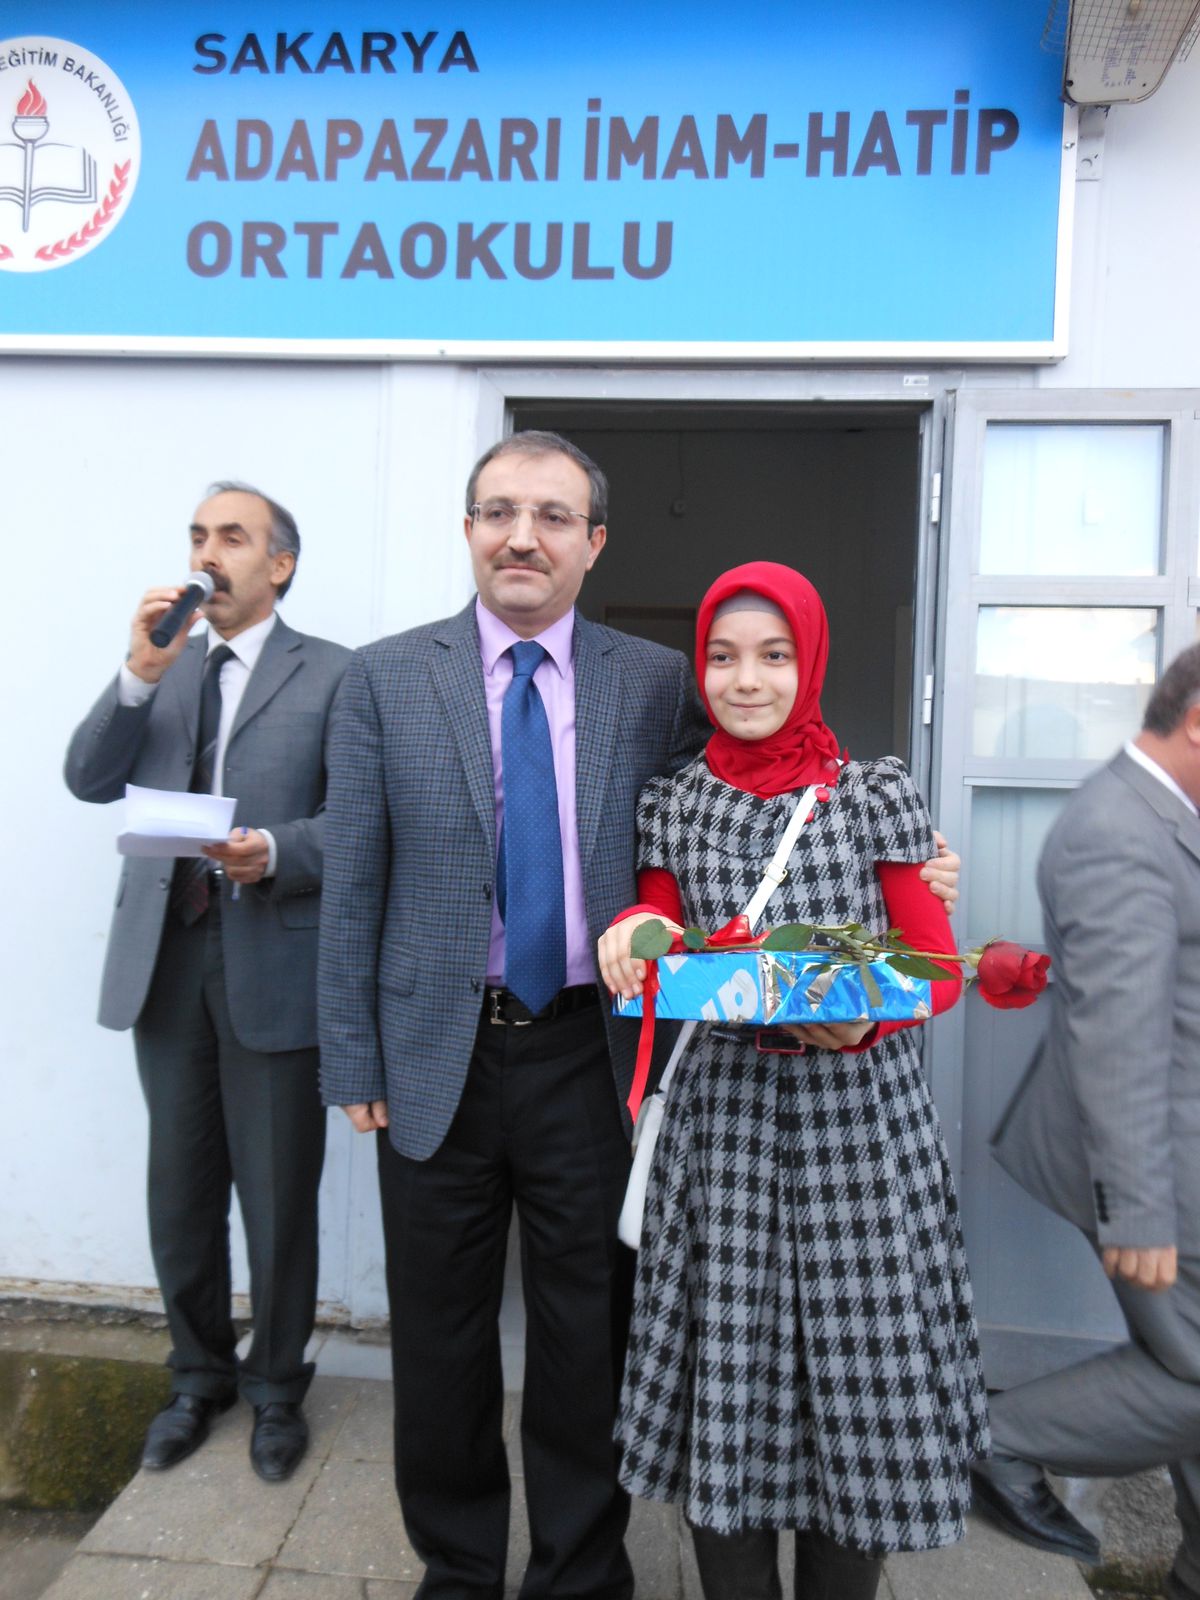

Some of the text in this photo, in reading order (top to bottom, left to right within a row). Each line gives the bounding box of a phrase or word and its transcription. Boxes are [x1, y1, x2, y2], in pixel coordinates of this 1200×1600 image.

[193, 31, 479, 74] SAKARYA
[62, 57, 131, 142] BAKANLIĞI
[188, 89, 1020, 180] ADAPAZARI İMAM-HATİP
[187, 221, 673, 279] ORTAOKULU
